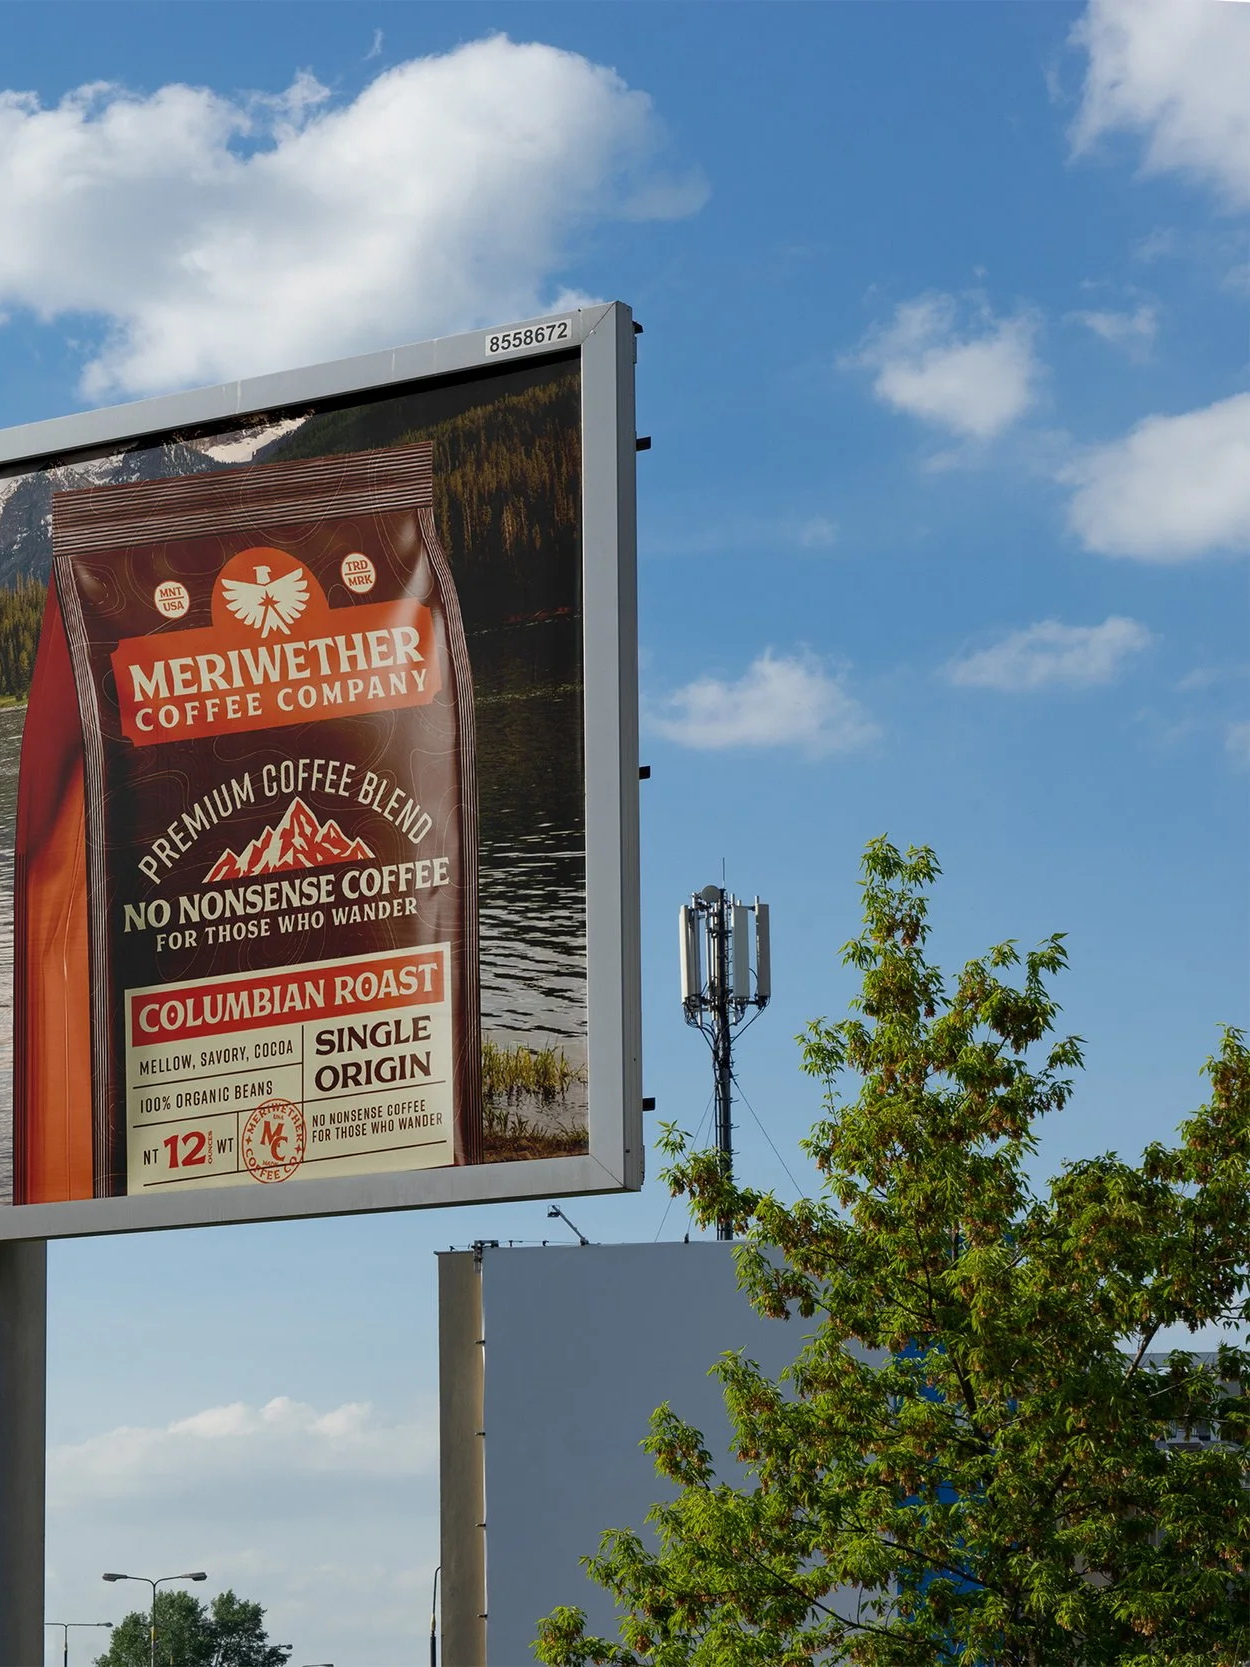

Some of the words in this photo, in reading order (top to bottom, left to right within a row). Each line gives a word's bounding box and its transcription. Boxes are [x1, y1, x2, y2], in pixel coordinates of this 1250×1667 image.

[489, 322, 568, 353] 8558672
[346, 559, 369, 571] TRD
[348, 574, 373, 587] MRK
[159, 586, 182, 598] MNT
[163, 601, 184, 612] USA
[128, 626, 425, 702] MERIWETHER
[135, 692, 262, 731] COFFEE
[277, 669, 428, 711] COMPANY
[138, 772, 255, 885] PREMIUM
[262, 758, 356, 797] COFFEE
[357, 771, 433, 845] BLEND
[123, 899, 171, 932] NO
[178, 874, 335, 924] NONSENSE
[341, 857, 450, 899] COFFEE
[156, 930, 197, 952] FOR
[205, 918, 270, 945] THOSE
[277, 910, 324, 933] WHO
[333, 897, 417, 925] WANDER
[138, 979, 325, 1033] COLUMBIAN
[334, 963, 439, 1006] ROAST
[315, 1015, 431, 1056] SINGLE
[139, 1054, 196, 1076] MELLOW,
[200, 1046, 250, 1067] SAVORY,
[254, 1040, 294, 1059] COCOA
[315, 1051, 431, 1092] ORIGIN
[140, 1095, 171, 1113] 100%
[176, 1086, 230, 1108] ORGANIC
[234, 1080, 273, 1100] BEANS
[312, 1114, 325, 1127] NO
[329, 1105, 383, 1125] NONSENSE
[387, 1099, 426, 1116] COFFEE
[247, 1103, 302, 1143] MERIWETHER
[312, 1128, 331, 1143] FOR
[335, 1119, 367, 1139] THOSE
[371, 1119, 394, 1134] WHO
[398, 1112, 443, 1130] WANDER
[143, 1149, 159, 1165] NT
[163, 1131, 207, 1169] 12
[216, 1138, 234, 1154] WT
[245, 1148, 281, 1180] COFFEE
